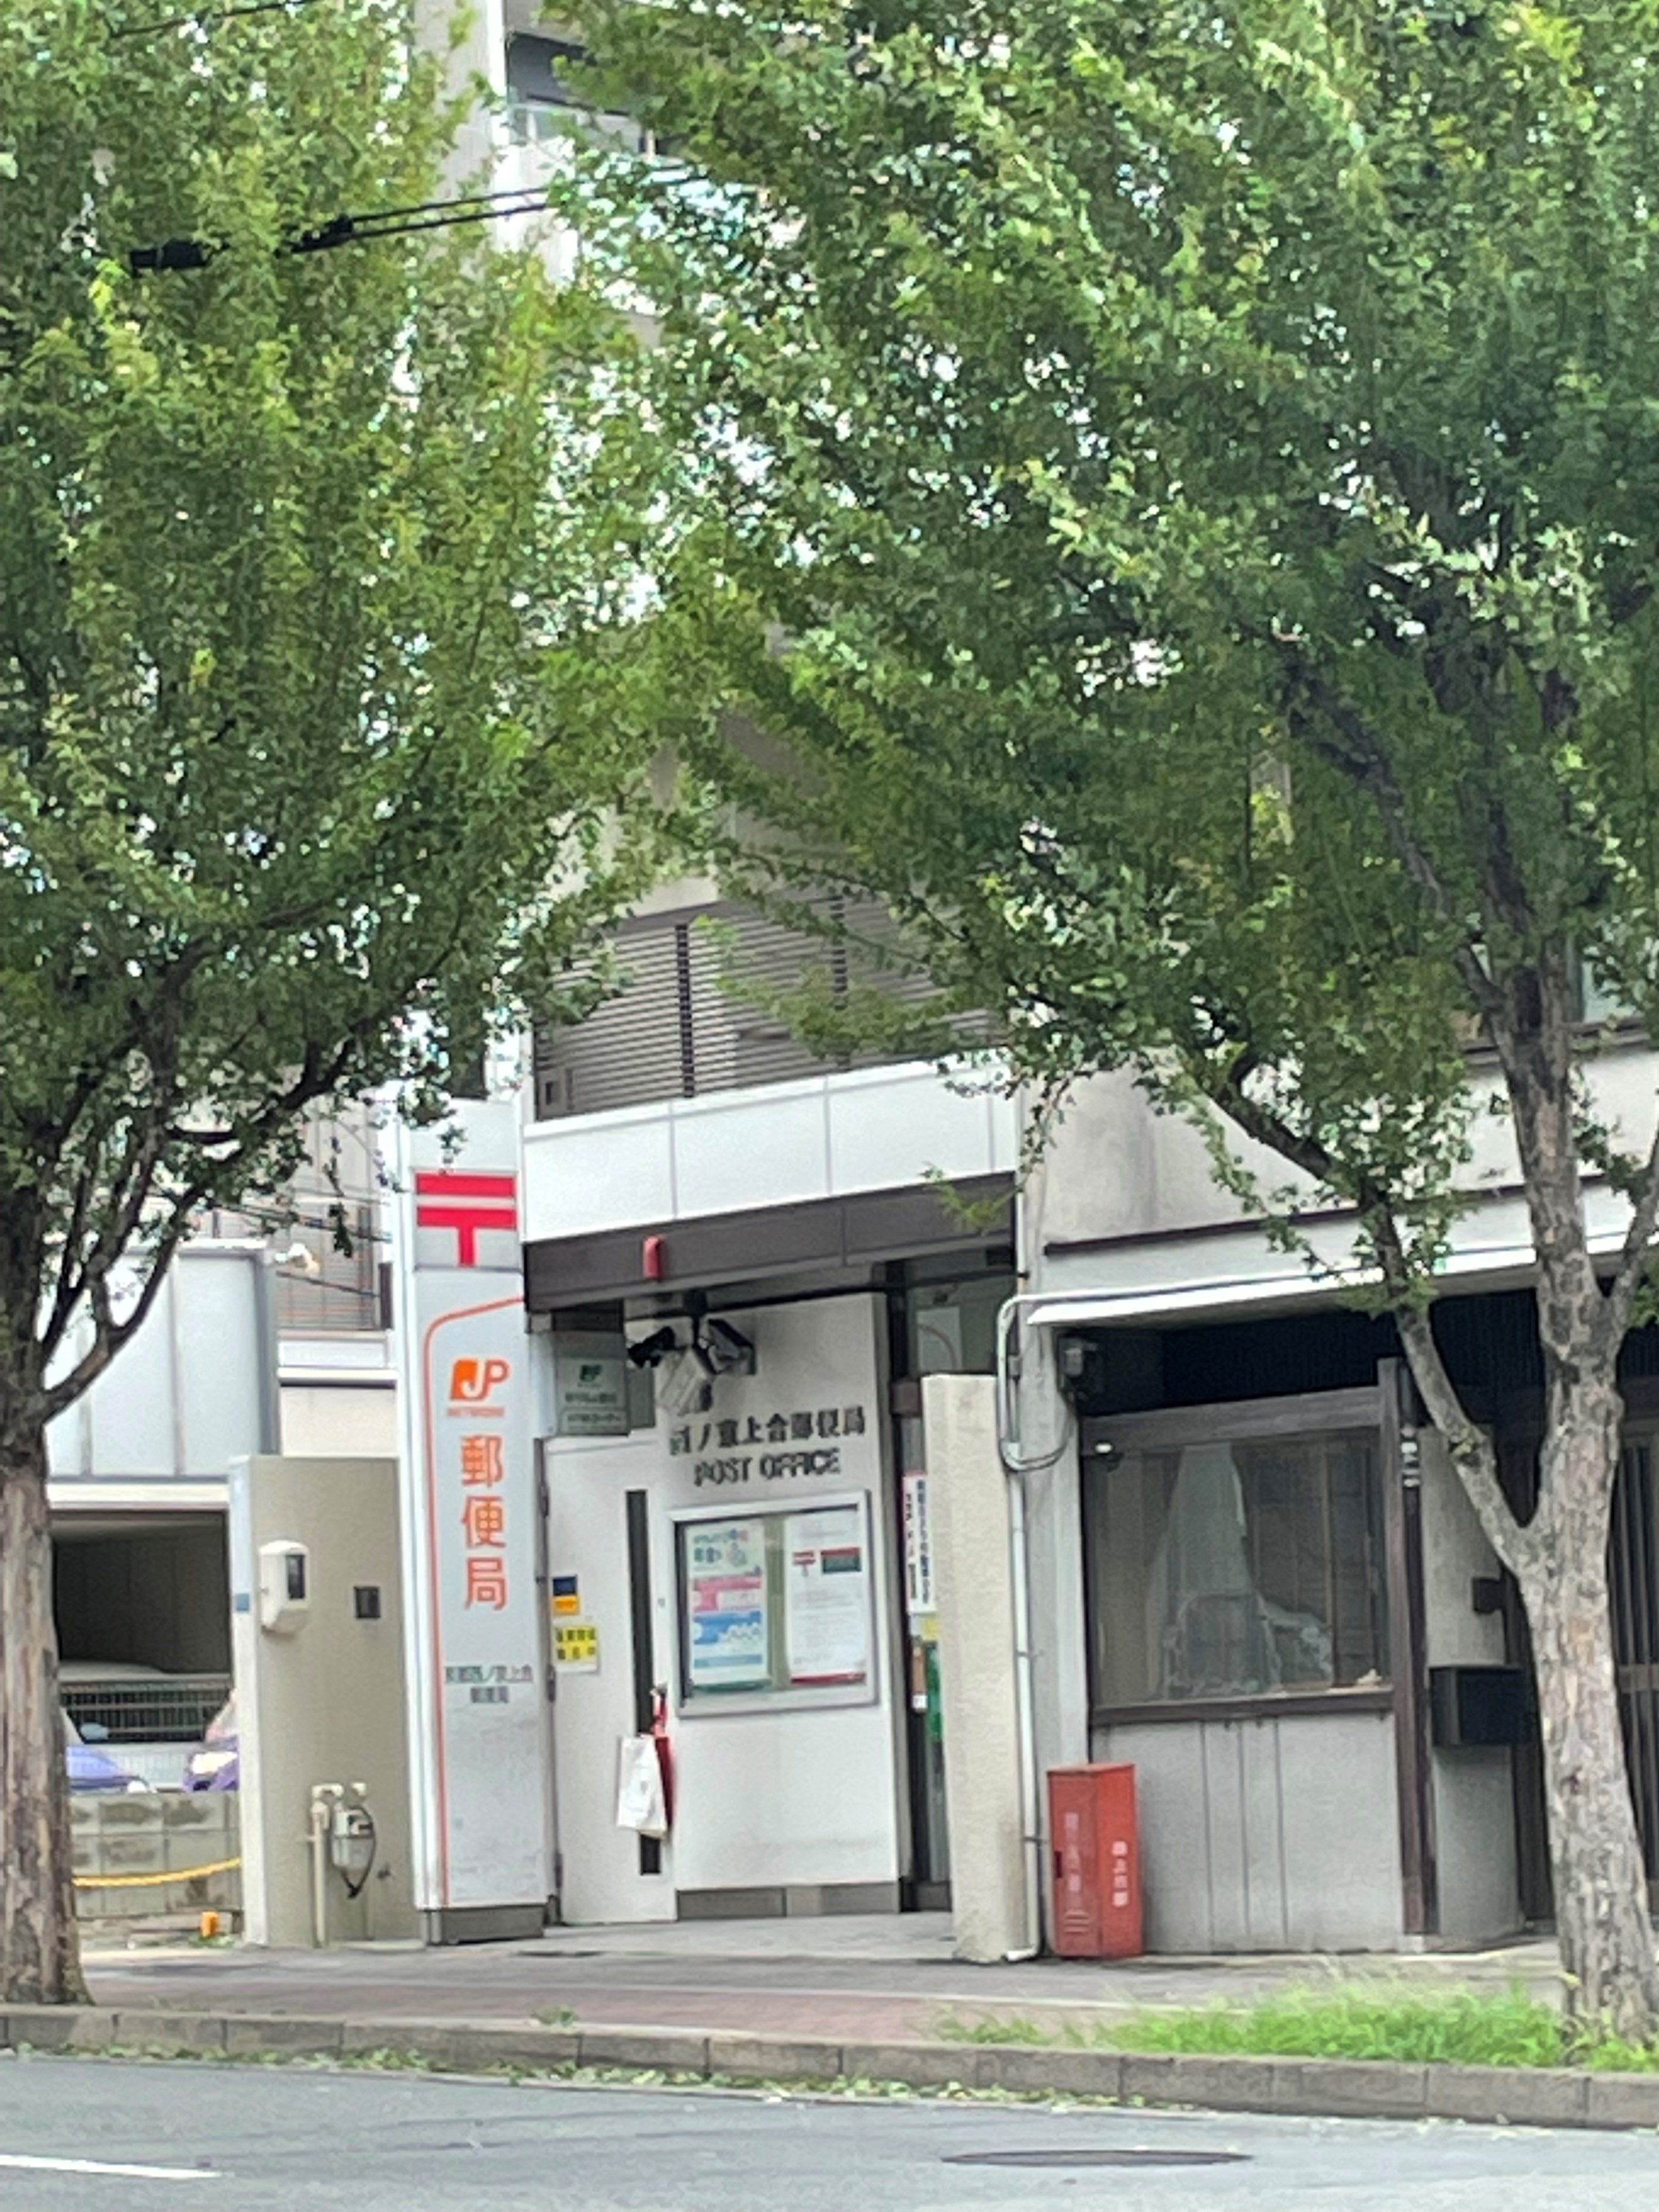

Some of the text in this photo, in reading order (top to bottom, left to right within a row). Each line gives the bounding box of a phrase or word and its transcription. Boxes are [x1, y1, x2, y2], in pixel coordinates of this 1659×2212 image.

[693, 1447, 840, 1487] POST OFFICE
[460, 1434, 507, 1610] 郵便局
